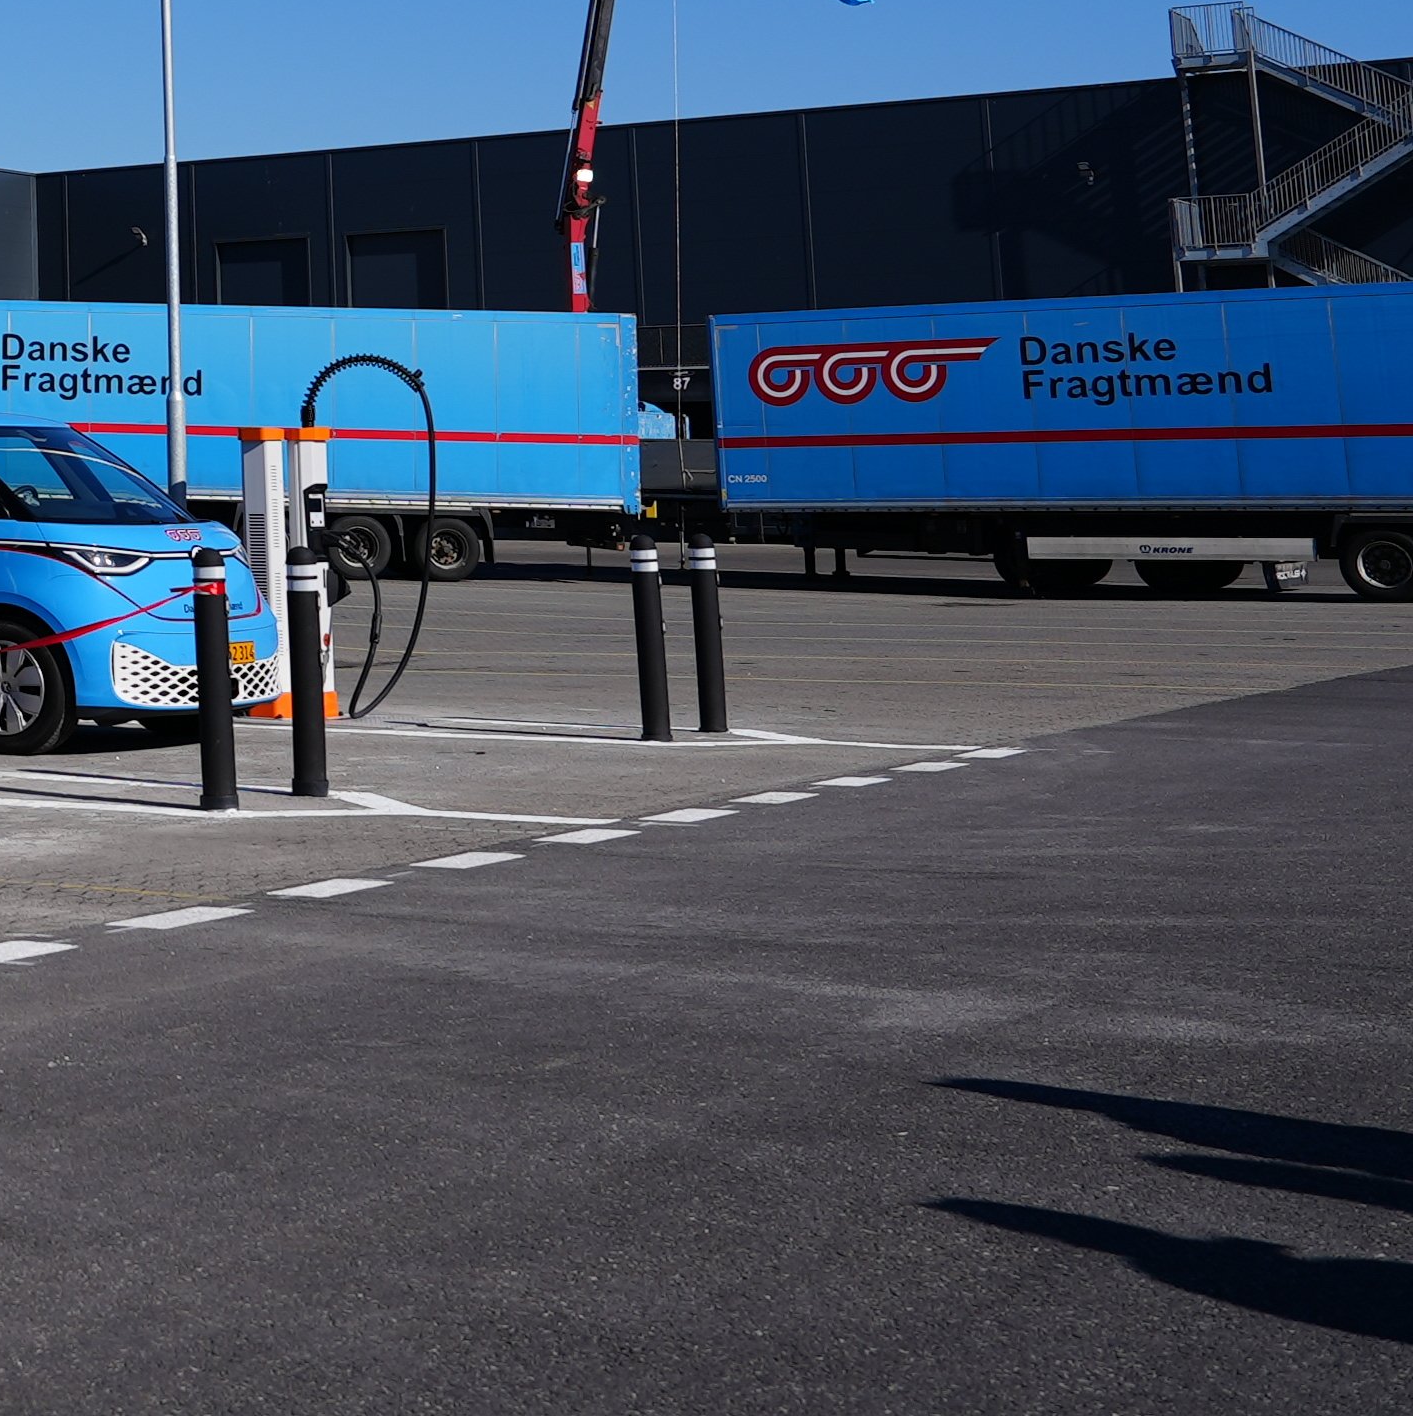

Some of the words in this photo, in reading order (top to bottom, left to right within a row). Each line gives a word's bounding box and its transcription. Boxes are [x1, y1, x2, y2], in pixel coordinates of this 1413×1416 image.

[1, 333, 131, 363] Danske
[1019, 332, 1177, 366] Danske
[673, 376, 691, 390] 87
[1022, 362, 1273, 406] Fragtmænd
[728, 475, 743, 483] CN
[745, 474, 767, 483] 2500
[1152, 546, 1194, 554] KRONE
